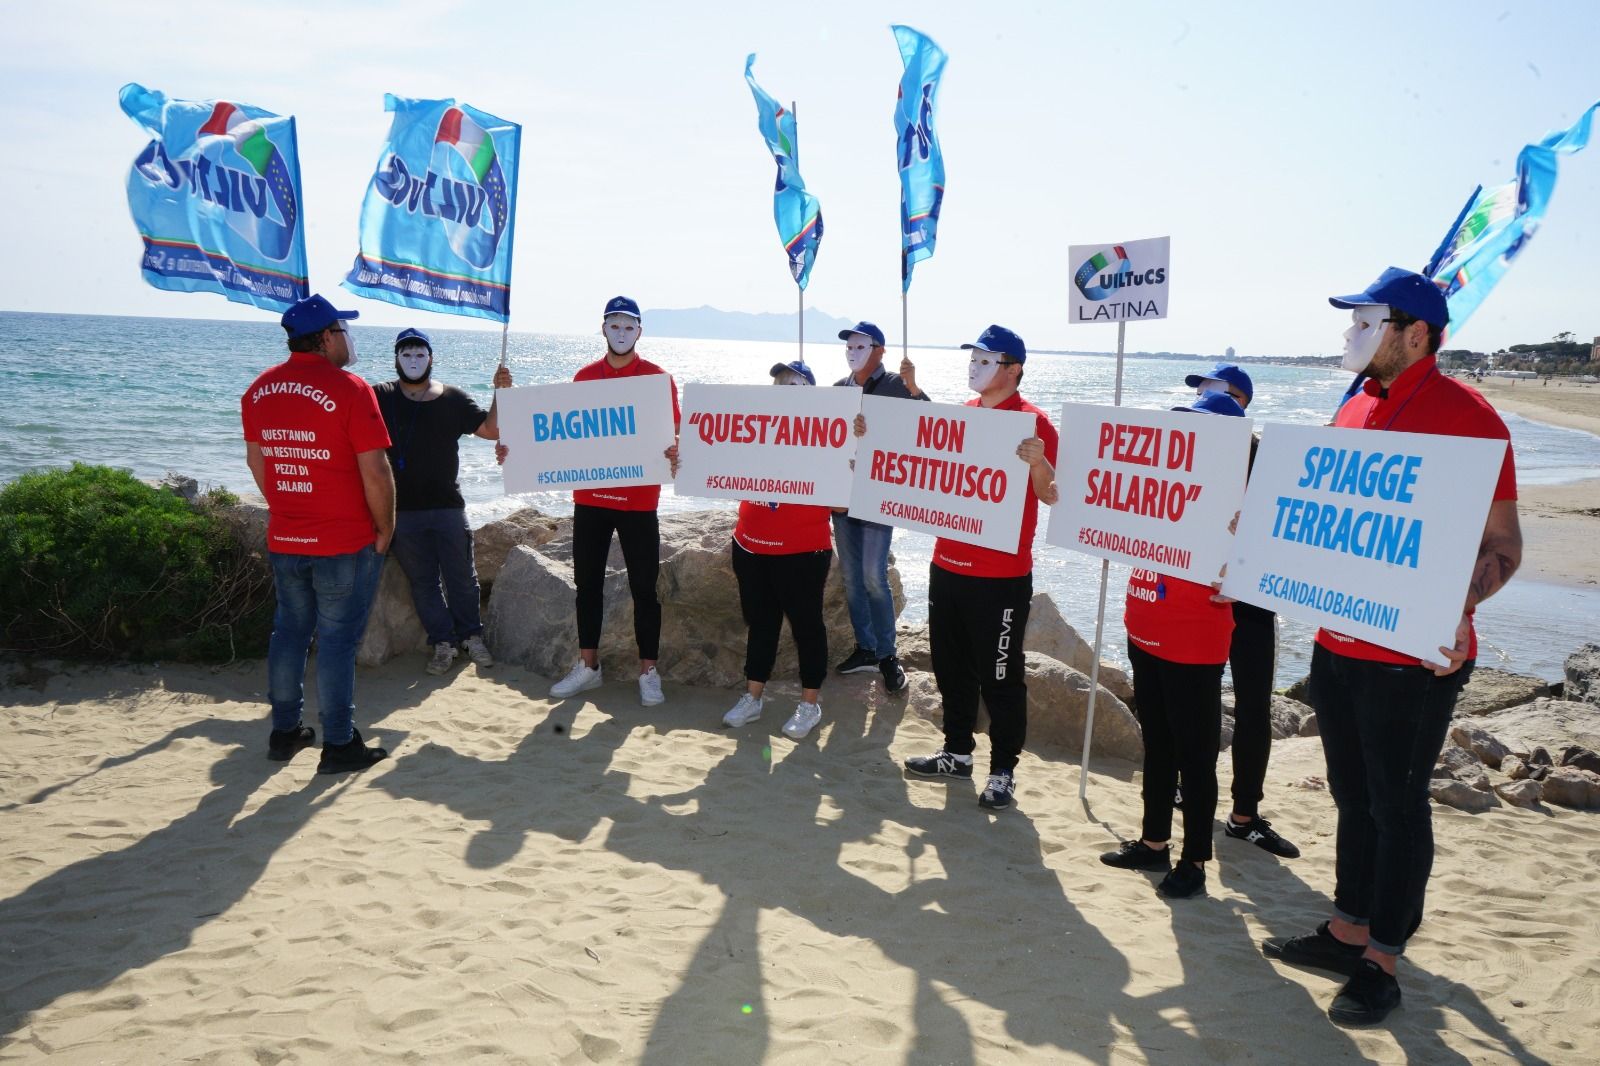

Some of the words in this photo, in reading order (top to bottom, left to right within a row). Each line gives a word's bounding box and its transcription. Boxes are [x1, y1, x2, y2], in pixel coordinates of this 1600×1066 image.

[1100, 268, 1166, 289] UILTuCS
[1079, 300, 1159, 320] LATINA
[252, 381, 336, 413] SALVATAGGIO
[261, 429, 316, 442] QUEST'ANNO
[532, 406, 636, 442] BAGNINI
[688, 412, 848, 448] "QUEST'ANNO
[916, 415, 966, 453] NON
[274, 446, 331, 460] RESTITUISCO
[1098, 422, 1162, 467] PEZZI
[1166, 430, 1196, 472] DI
[274, 464, 297, 475] PEZZI
[299, 465, 309, 476] DI
[277, 480, 313, 493] SALARIO
[538, 465, 644, 484] #SCANDALOBAGNINI
[706, 475, 815, 496] #SCANDALOBAGNINI
[870, 449, 1008, 504] RESTITUISCO
[1297, 446, 1423, 503] SPIAGGE
[1084, 468, 1203, 522] SALARIO"
[880, 500, 983, 536] #SCANDALOBAGNINI
[1271, 496, 1423, 569] TERRACINA
[1078, 527, 1192, 570] #SCANDALOBAGNINI
[1146, 570, 1158, 583] DI
[1258, 572, 1400, 632] #SCANDALOBAGNINI
[996, 608, 1014, 680] GIVOVA
